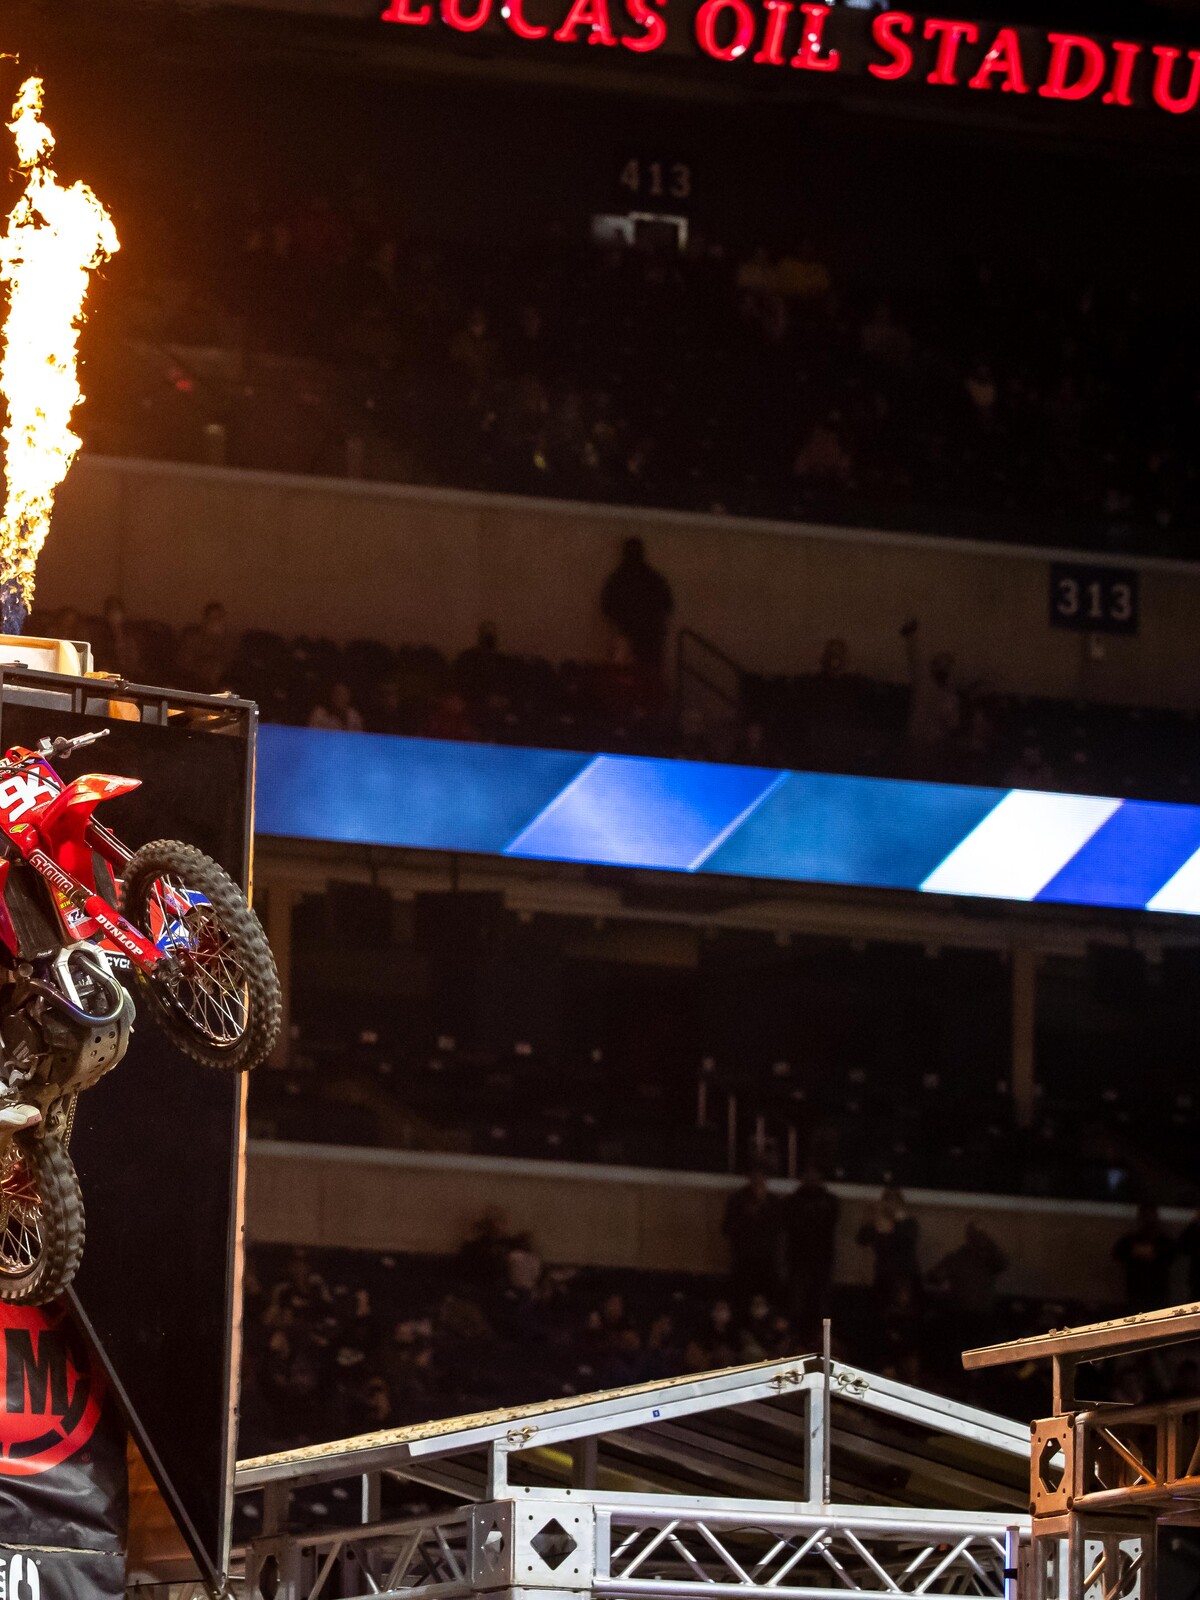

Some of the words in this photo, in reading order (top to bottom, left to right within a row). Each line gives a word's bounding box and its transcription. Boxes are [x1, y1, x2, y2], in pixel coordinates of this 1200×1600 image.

[695, 0, 840, 72] OIL
[868, 11, 1200, 114] STADIU
[620, 158, 692, 198] 413
[1057, 577, 1134, 622] 313
[30, 854, 74, 894] SHOWA
[95, 914, 144, 957] DUNLOP
